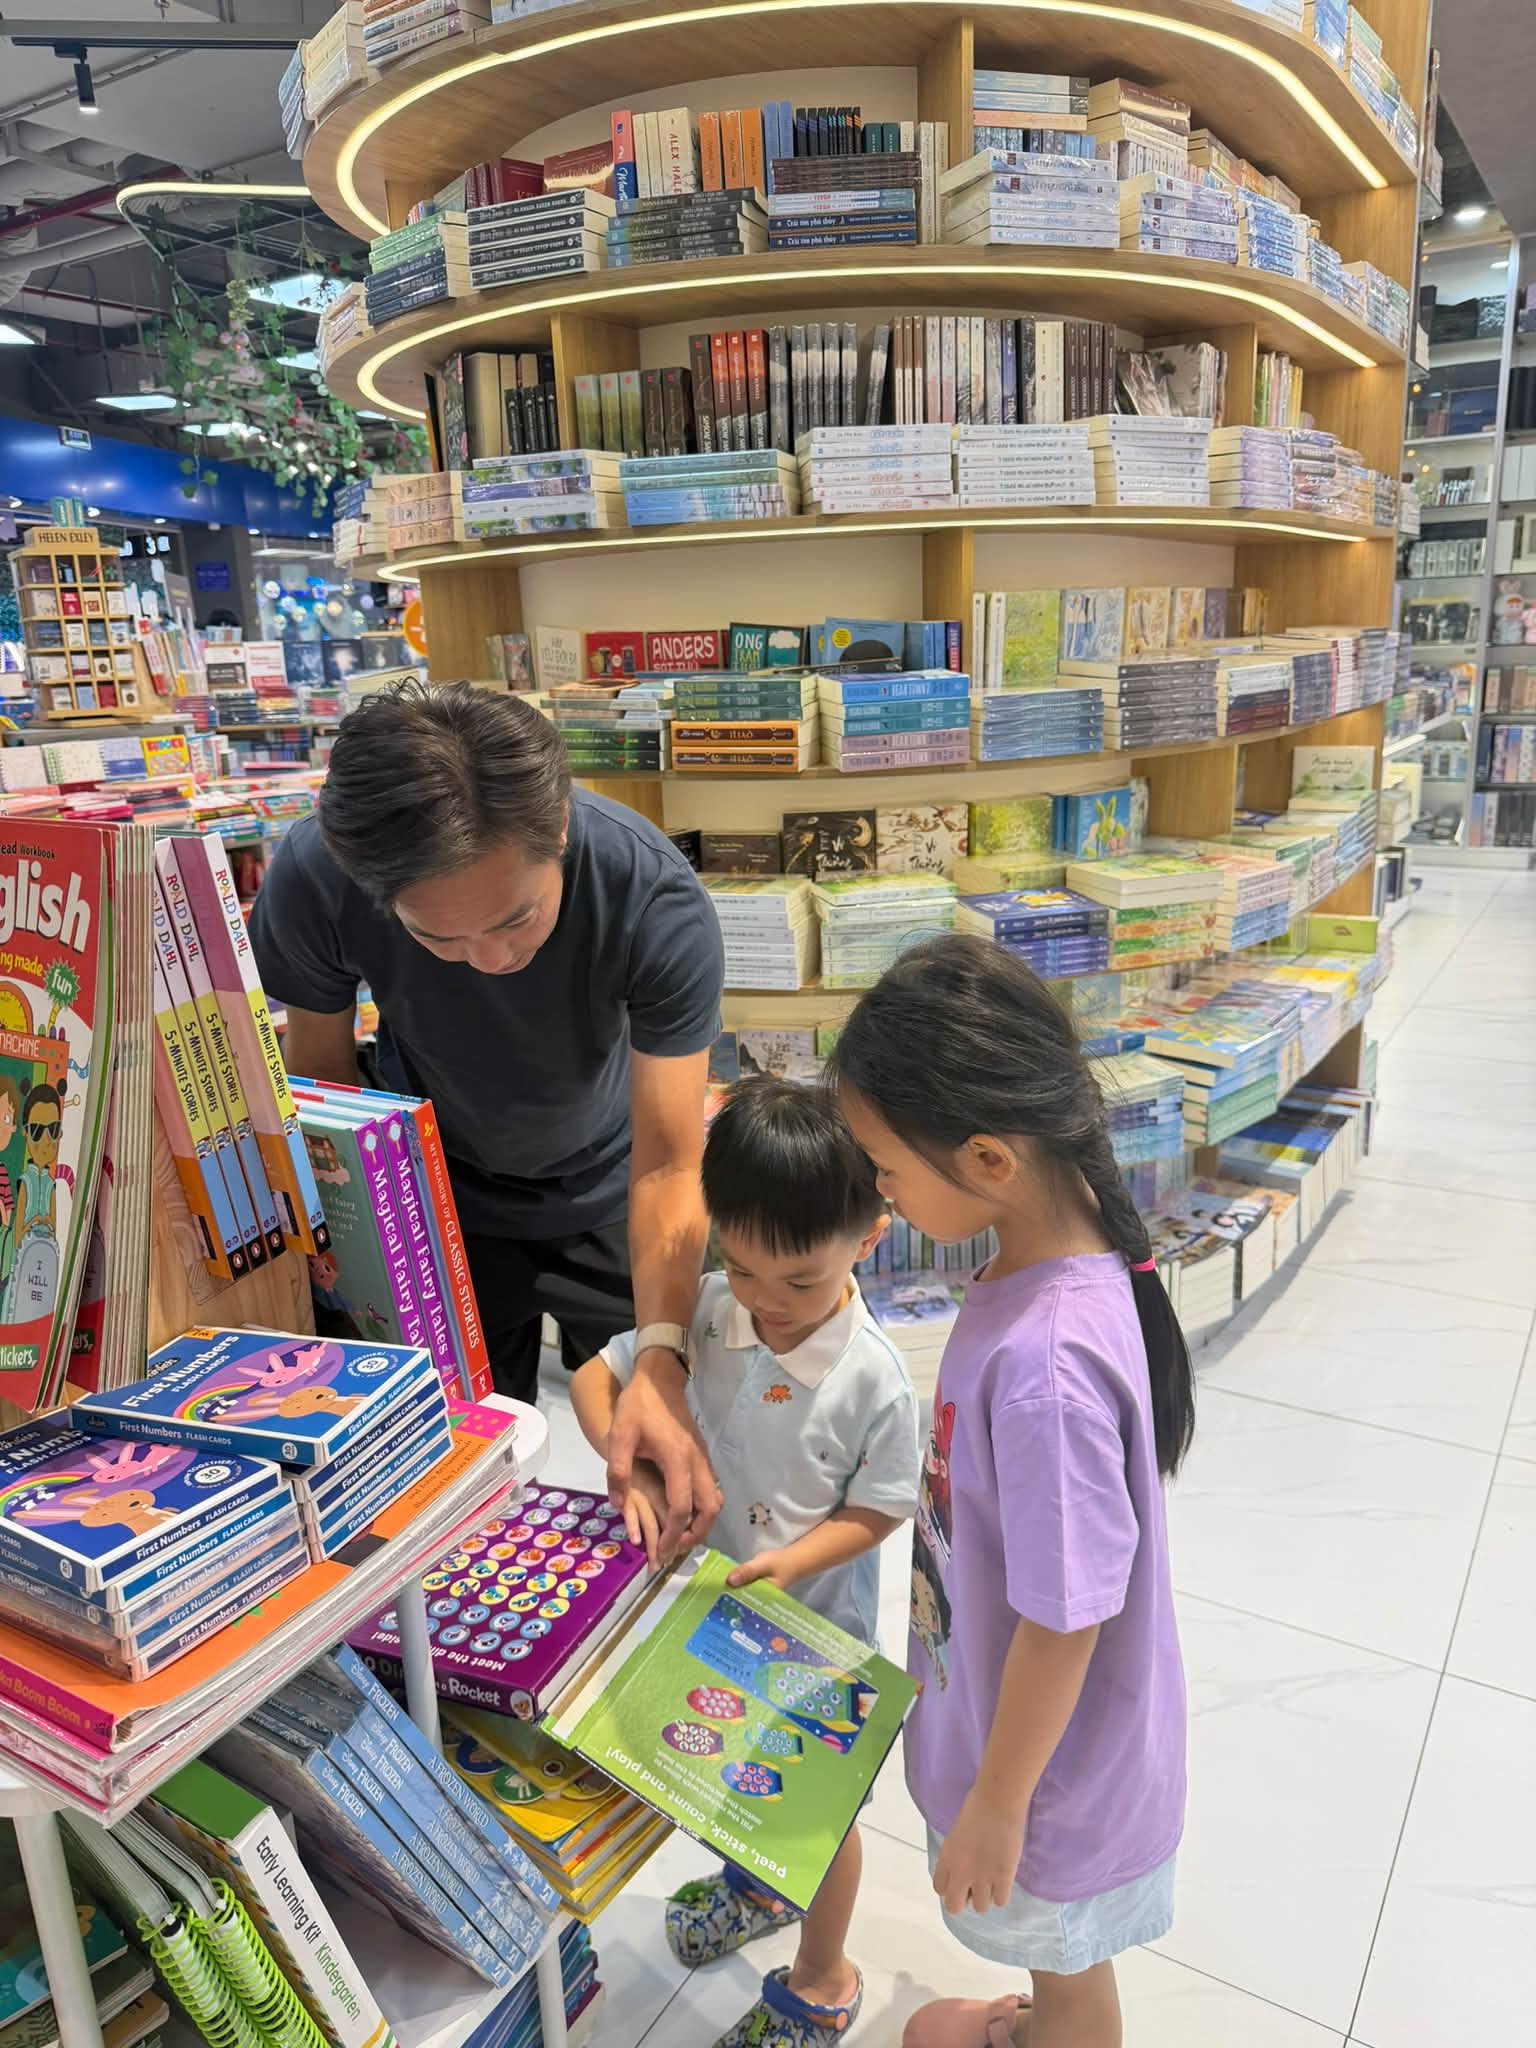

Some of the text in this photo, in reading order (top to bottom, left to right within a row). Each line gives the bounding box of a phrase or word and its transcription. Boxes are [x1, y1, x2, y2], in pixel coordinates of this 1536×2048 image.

[669, 133, 683, 193] ALEX HALE
[38, 532, 94, 543] HELEN EXLEY
[652, 636, 714, 661] ANDERS
[20, 844, 56, 860] Workbook
[166, 873, 200, 963] ROALD DAHL
[215, 868, 249, 957] ROALD DAHL
[14, 955, 45, 977] made
[158, 931, 178, 970] DAHL
[51, 968, 74, 997] fun
[184, 1021, 219, 1113] 5-MINUTE STORIES
[206, 1012, 240, 1104] 5-MINUTE STORIES
[254, 1008, 287, 1099] 5-MINUTE STORIES
[164, 1030, 200, 1122] 5-MINUTE STORIES
[433, 1158, 448, 1205] TREASURY
[443, 1206, 451, 1218] OF
[372, 1166, 425, 1349] Magical Fairy Tal
[397, 1157, 449, 1357] Magical Fairy Tales
[445, 1220, 466, 1286] CLASSIC
[28, 1276, 48, 1287] WILL
[31, 1291, 43, 1301] BE
[459, 1284, 480, 1350] STORIES
[121, 1377, 172, 1408] First
[162, 1335, 240, 1383] Numbers
[171, 1372, 201, 1393] FLASH
[200, 1354, 231, 1374] CARDS
[120, 1420, 232, 1445] First Numbers FLASH CARDS
[348, 1421, 362, 1436] First
[361, 1399, 388, 1423] Numbers
[6, 1454, 49, 1474] FLASH
[8, 1429, 84, 1461] Numb
[333, 1452, 351, 1470] First
[351, 1427, 383, 1457] Numbers
[200, 1468, 220, 1480] 30
[342, 1470, 359, 1490] First
[359, 1447, 390, 1475] Numbers
[344, 1492, 361, 1511] First
[361, 1467, 392, 1496] Numbers
[136, 1493, 249, 1560] First Numbers FLASH CARDS
[347, 1512, 365, 1531] First
[365, 1488, 396, 1518] Numbers
[156, 1509, 265, 1579] First Numbers FLASH CARDS
[168, 1606, 191, 1625] First
[190, 1581, 230, 1611] Numbers
[178, 1627, 200, 1647] First
[200, 1603, 240, 1633] Numbers
[371, 1631, 401, 1644] side!
[449, 1651, 470, 1664] the
[473, 1657, 507, 1671] Meet
[14, 1678, 46, 1707] Boom
[47, 1696, 81, 1726] Boom
[367, 1682, 400, 1721] FROZEN
[448, 1677, 502, 1706] Rocket
[356, 1767, 385, 1805] FROZEN
[375, 1752, 405, 1792] FROZEN
[427, 1756, 490, 1828] A FROZEN WORLD
[337, 1781, 367, 1820] FROZEN
[605, 1746, 787, 1879] Peel, stick, count and play!
[399, 1854, 425, 1890] FROZEN
[423, 1884, 449, 1914] WORLD
[416, 1838, 441, 1875] FROZEN
[440, 1869, 464, 1899] WORLD
[255, 1835, 361, 2022] Early Learning Kit Kindergarten
